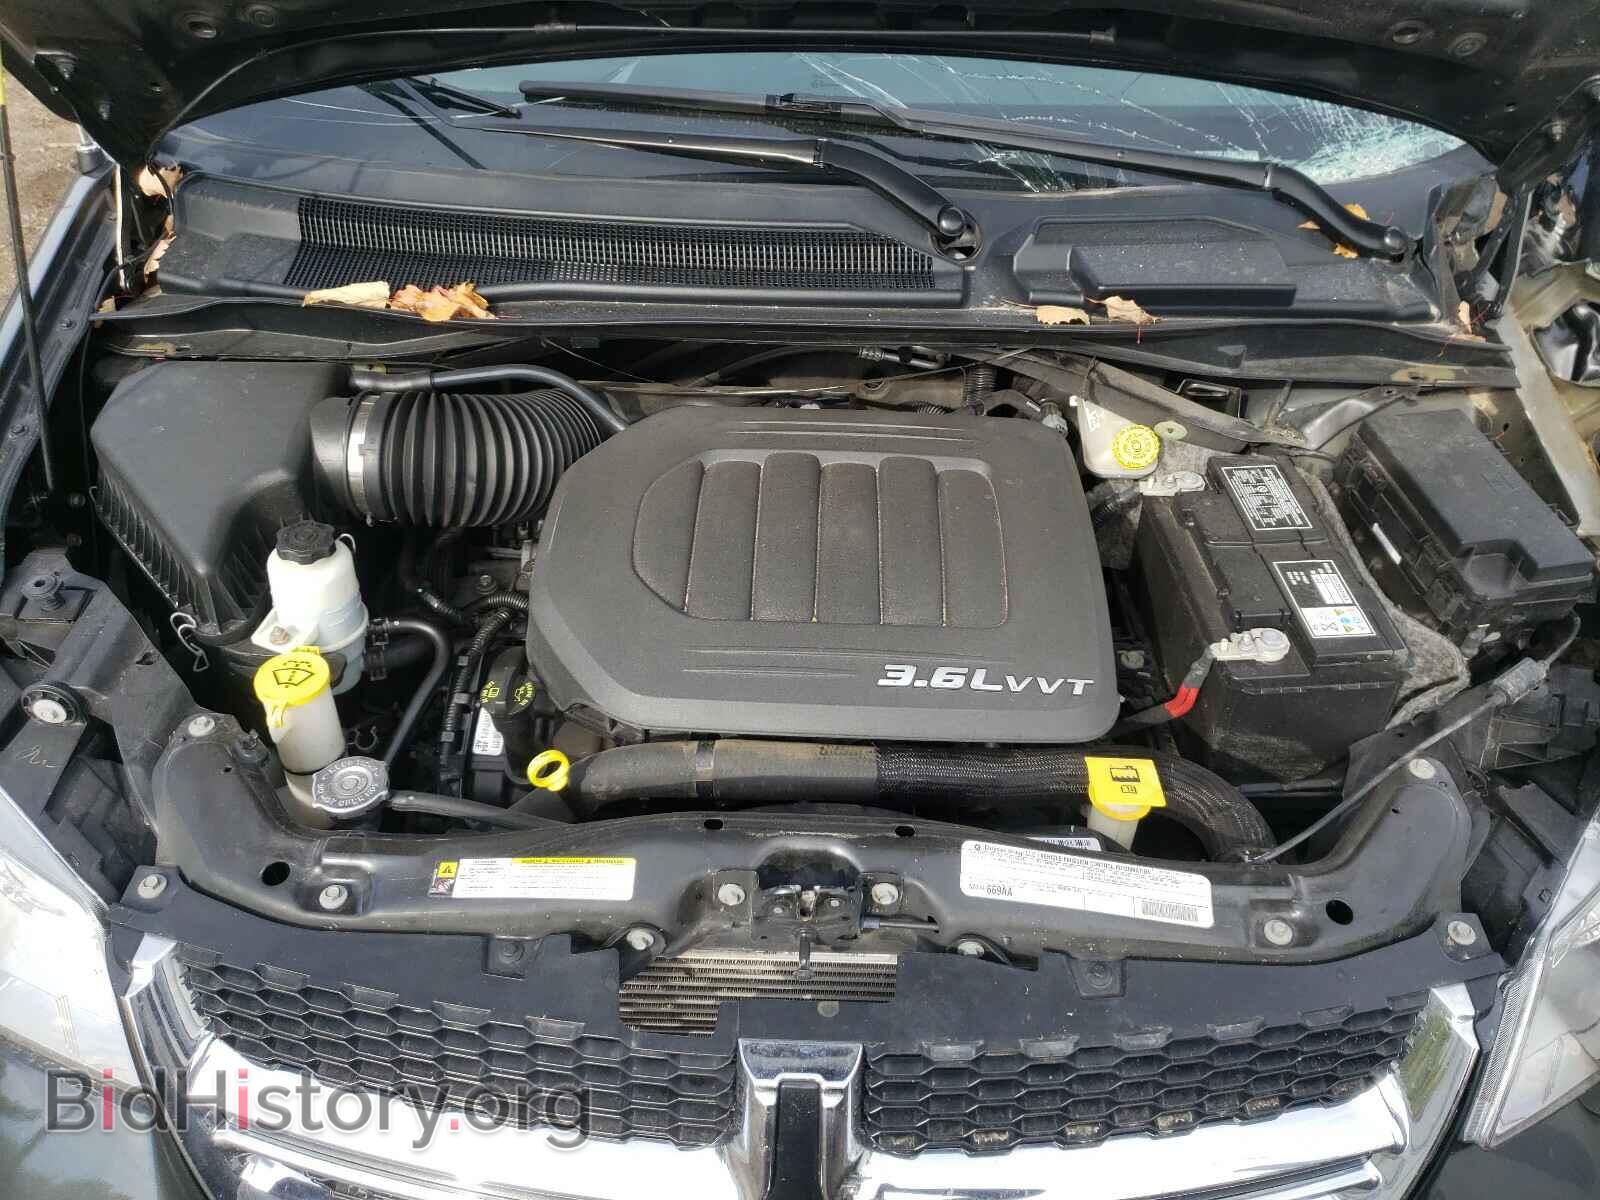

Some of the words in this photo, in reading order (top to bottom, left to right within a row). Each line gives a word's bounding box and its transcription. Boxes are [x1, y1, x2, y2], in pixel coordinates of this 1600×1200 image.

[877, 664, 1003, 691] 3.6L
[1006, 675, 1094, 695] VVT
[986, 885, 1013, 897] 669AA
